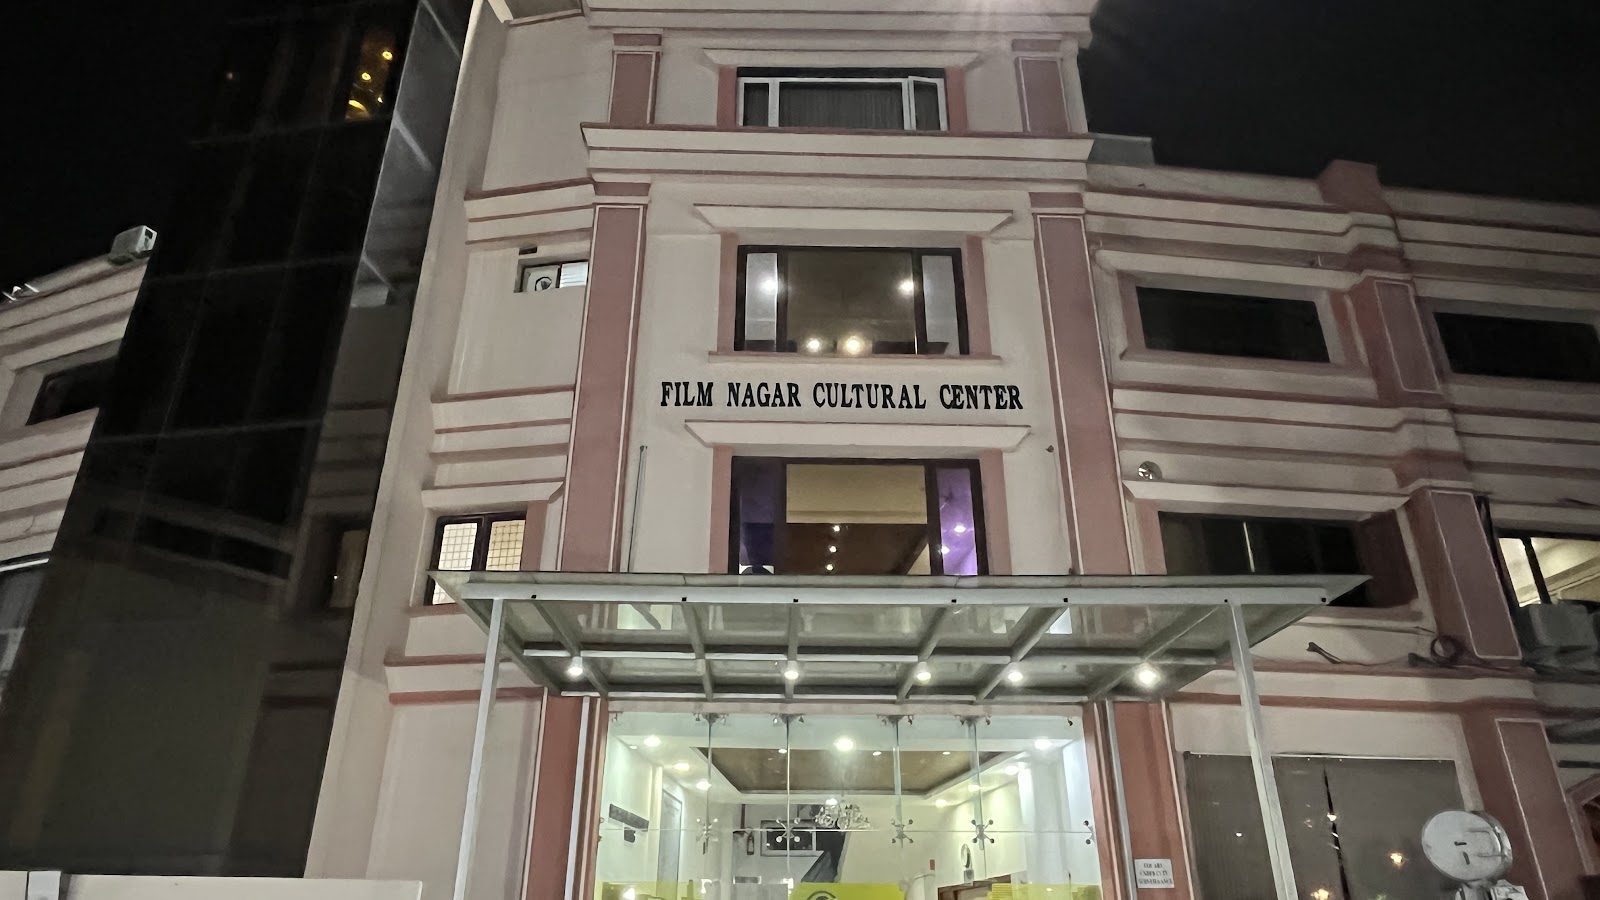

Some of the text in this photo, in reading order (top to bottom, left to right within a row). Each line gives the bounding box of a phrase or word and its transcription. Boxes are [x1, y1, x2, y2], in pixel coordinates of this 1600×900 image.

[660, 381, 1024, 410] FILM NAGAR CULTURAL CENTER
